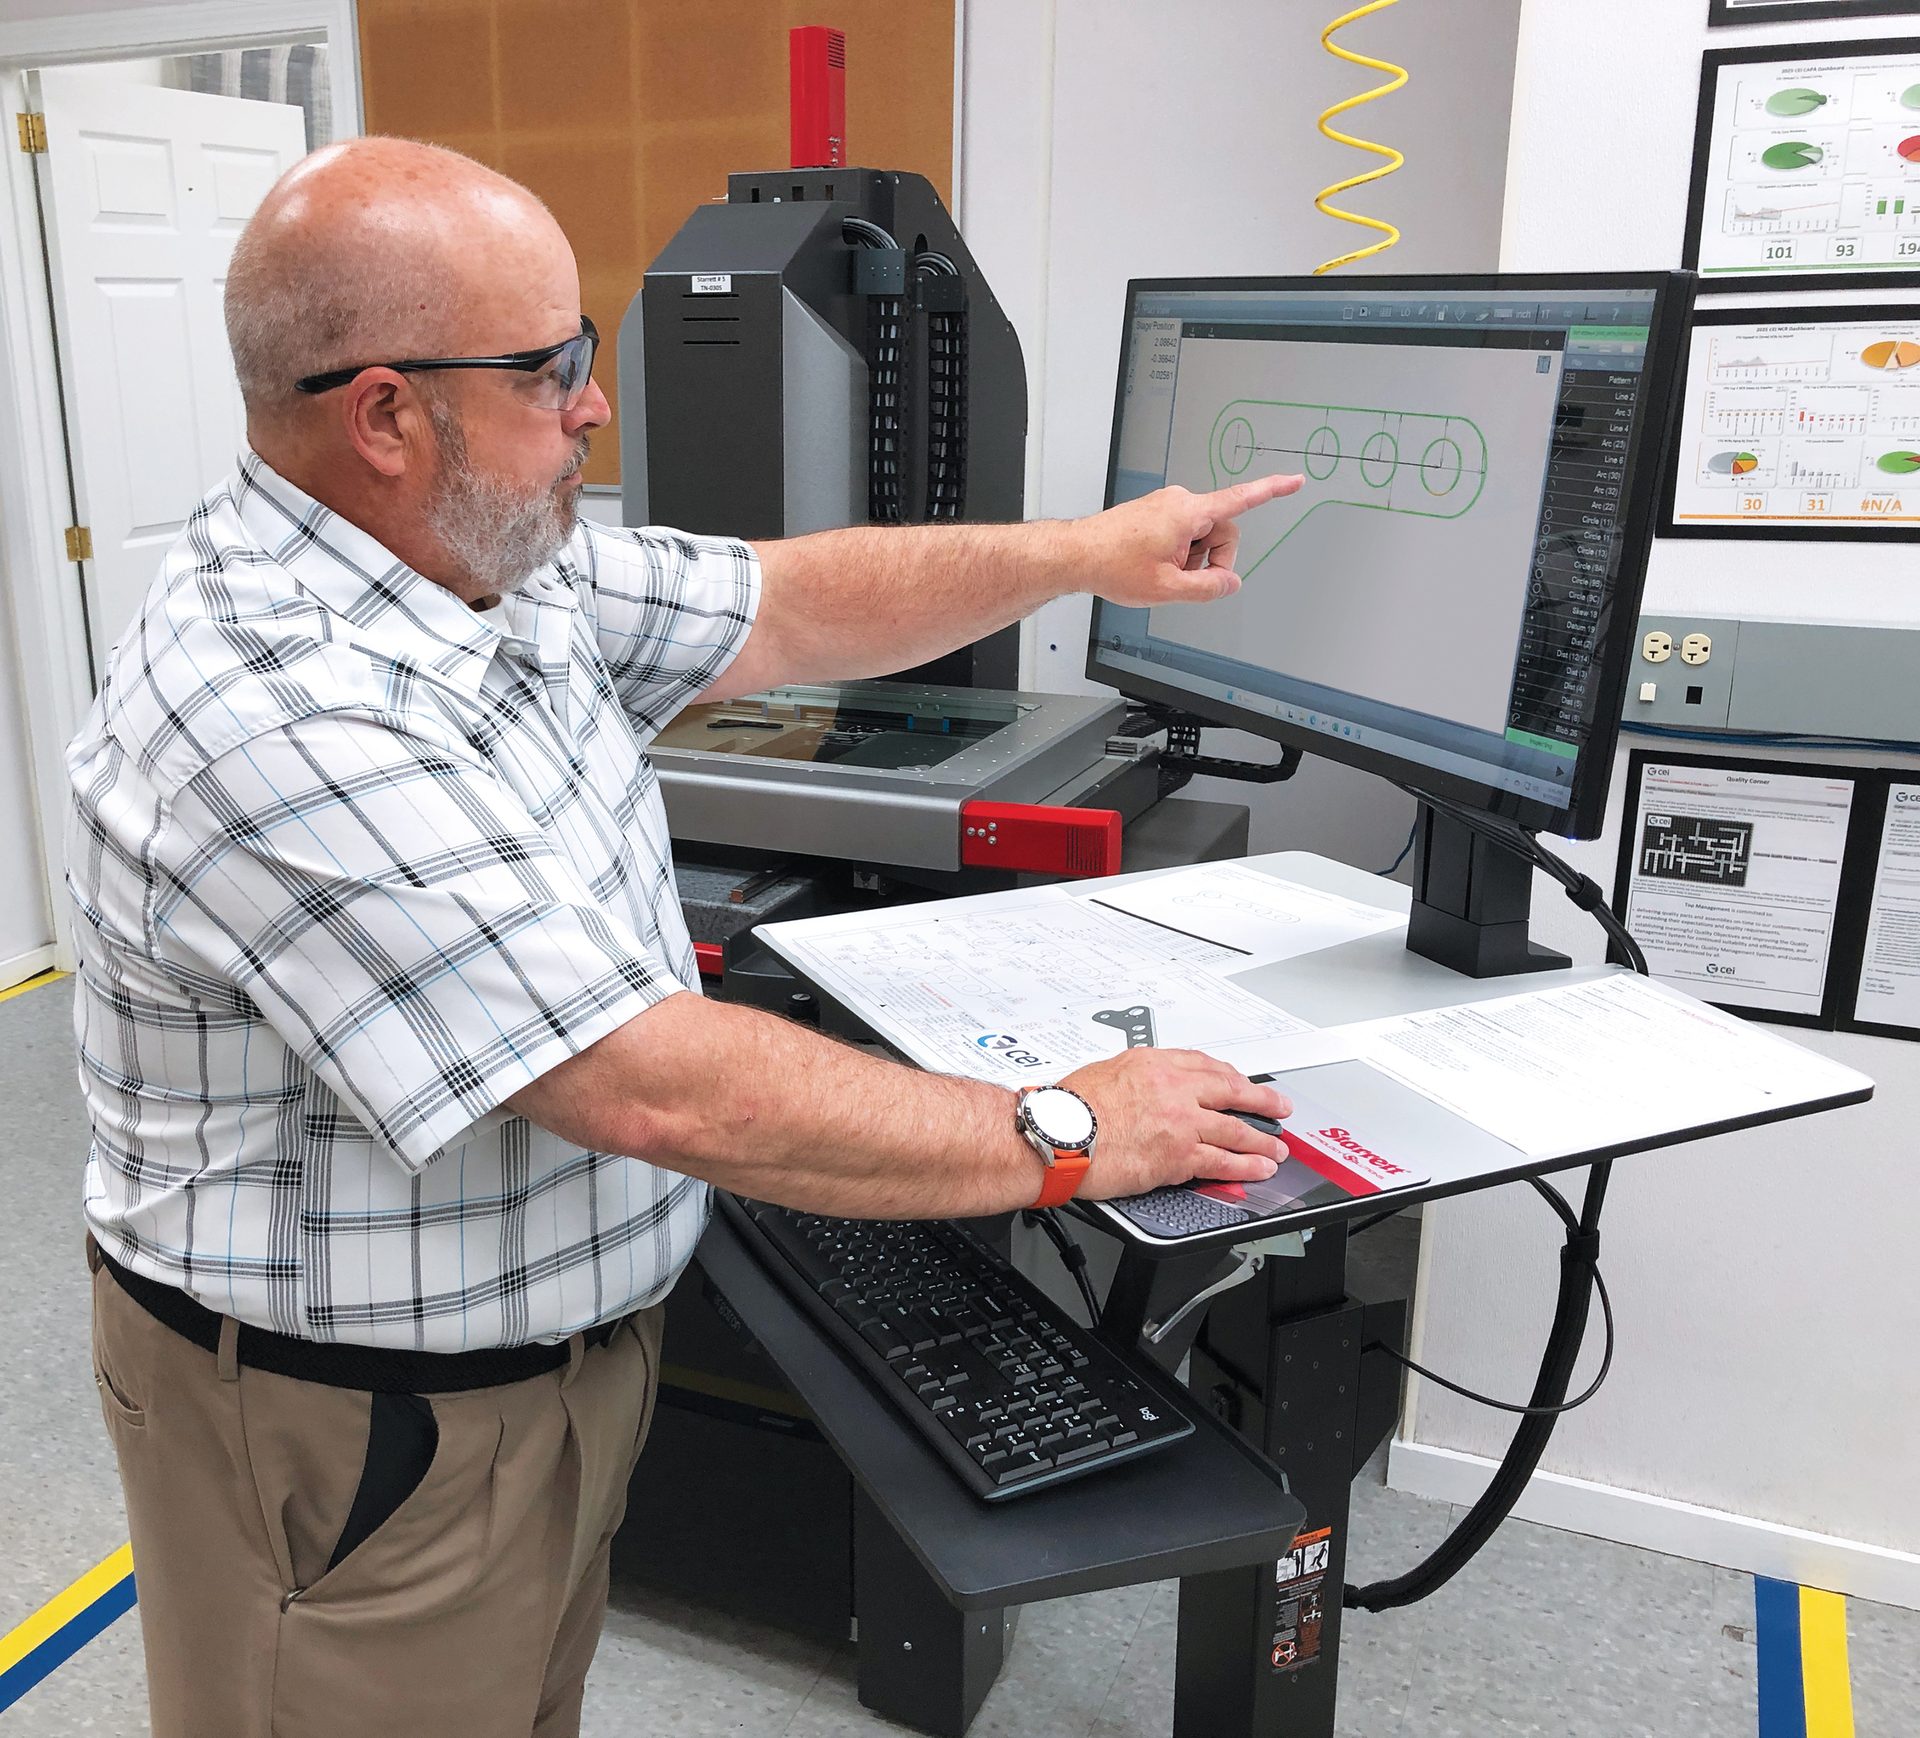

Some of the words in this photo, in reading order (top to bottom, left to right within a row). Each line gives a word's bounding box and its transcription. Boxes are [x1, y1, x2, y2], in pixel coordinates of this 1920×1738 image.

[1766, 247, 1793, 259] 101
[1835, 244, 1855, 257] 93
[1136, 321, 1150, 332] Stage
[1151, 321, 1175, 331] Position
[1608, 375, 1632, 385] Pattern
[1615, 392, 1628, 400] Line
[1614, 409, 1625, 417] Arc
[1626, 409, 1632, 417] 3
[1609, 424, 1623, 432] Line
[1601, 439, 1612, 447] Arc
[1604, 456, 1618, 464] Line
[1596, 471, 1607, 479] Arc
[1593, 486, 1604, 494] Arc
[1591, 501, 1602, 510] Arc
[1603, 503, 1615, 512] (22)
[1744, 499, 1762, 511] 30
[1807, 499, 1825, 511] 31
[1860, 498, 1902, 513] #N/A
[1582, 516, 1599, 525] Circle
[1600, 518, 1613, 528] (11)
[1584, 531, 1601, 541] Circle
[1577, 546, 1594, 555] Circle
[1574, 561, 1591, 570] Circle
[1571, 576, 1588, 585] Circle
[1569, 590, 1586, 600] Circle
[1566, 621, 1586, 632] Datum
[1571, 637, 1583, 647] Dist
[1556, 650, 1569, 659] Dist
[1566, 667, 1578, 676] Dist
[1564, 682, 1576, 690] Dist
[1561, 696, 1573, 706] Dist
[1559, 711, 1571, 720] Dist
[1556, 725, 1568, 735] Blob
[1658, 768, 1669, 776] cei
[1726, 776, 1748, 784] Quality
[1696, 904, 1730, 912] Management
[1681, 920, 1713, 928] expectations
[1634, 928, 1667, 936] Management
[1635, 922, 1664, 930] establishing
[1665, 926, 1693, 934] meaningful
[1713, 931, 1740, 939] Objectives
[1752, 936, 1779, 944] improving
[1676, 948, 1705, 956] understood
[1720, 947, 1755, 955] Management
[1720, 967, 1736, 975] cei
[1005, 1049, 1052, 1068] cei
[1319, 1128, 1406, 1175] Starrett
[1139, 1406, 1160, 1421] logi
